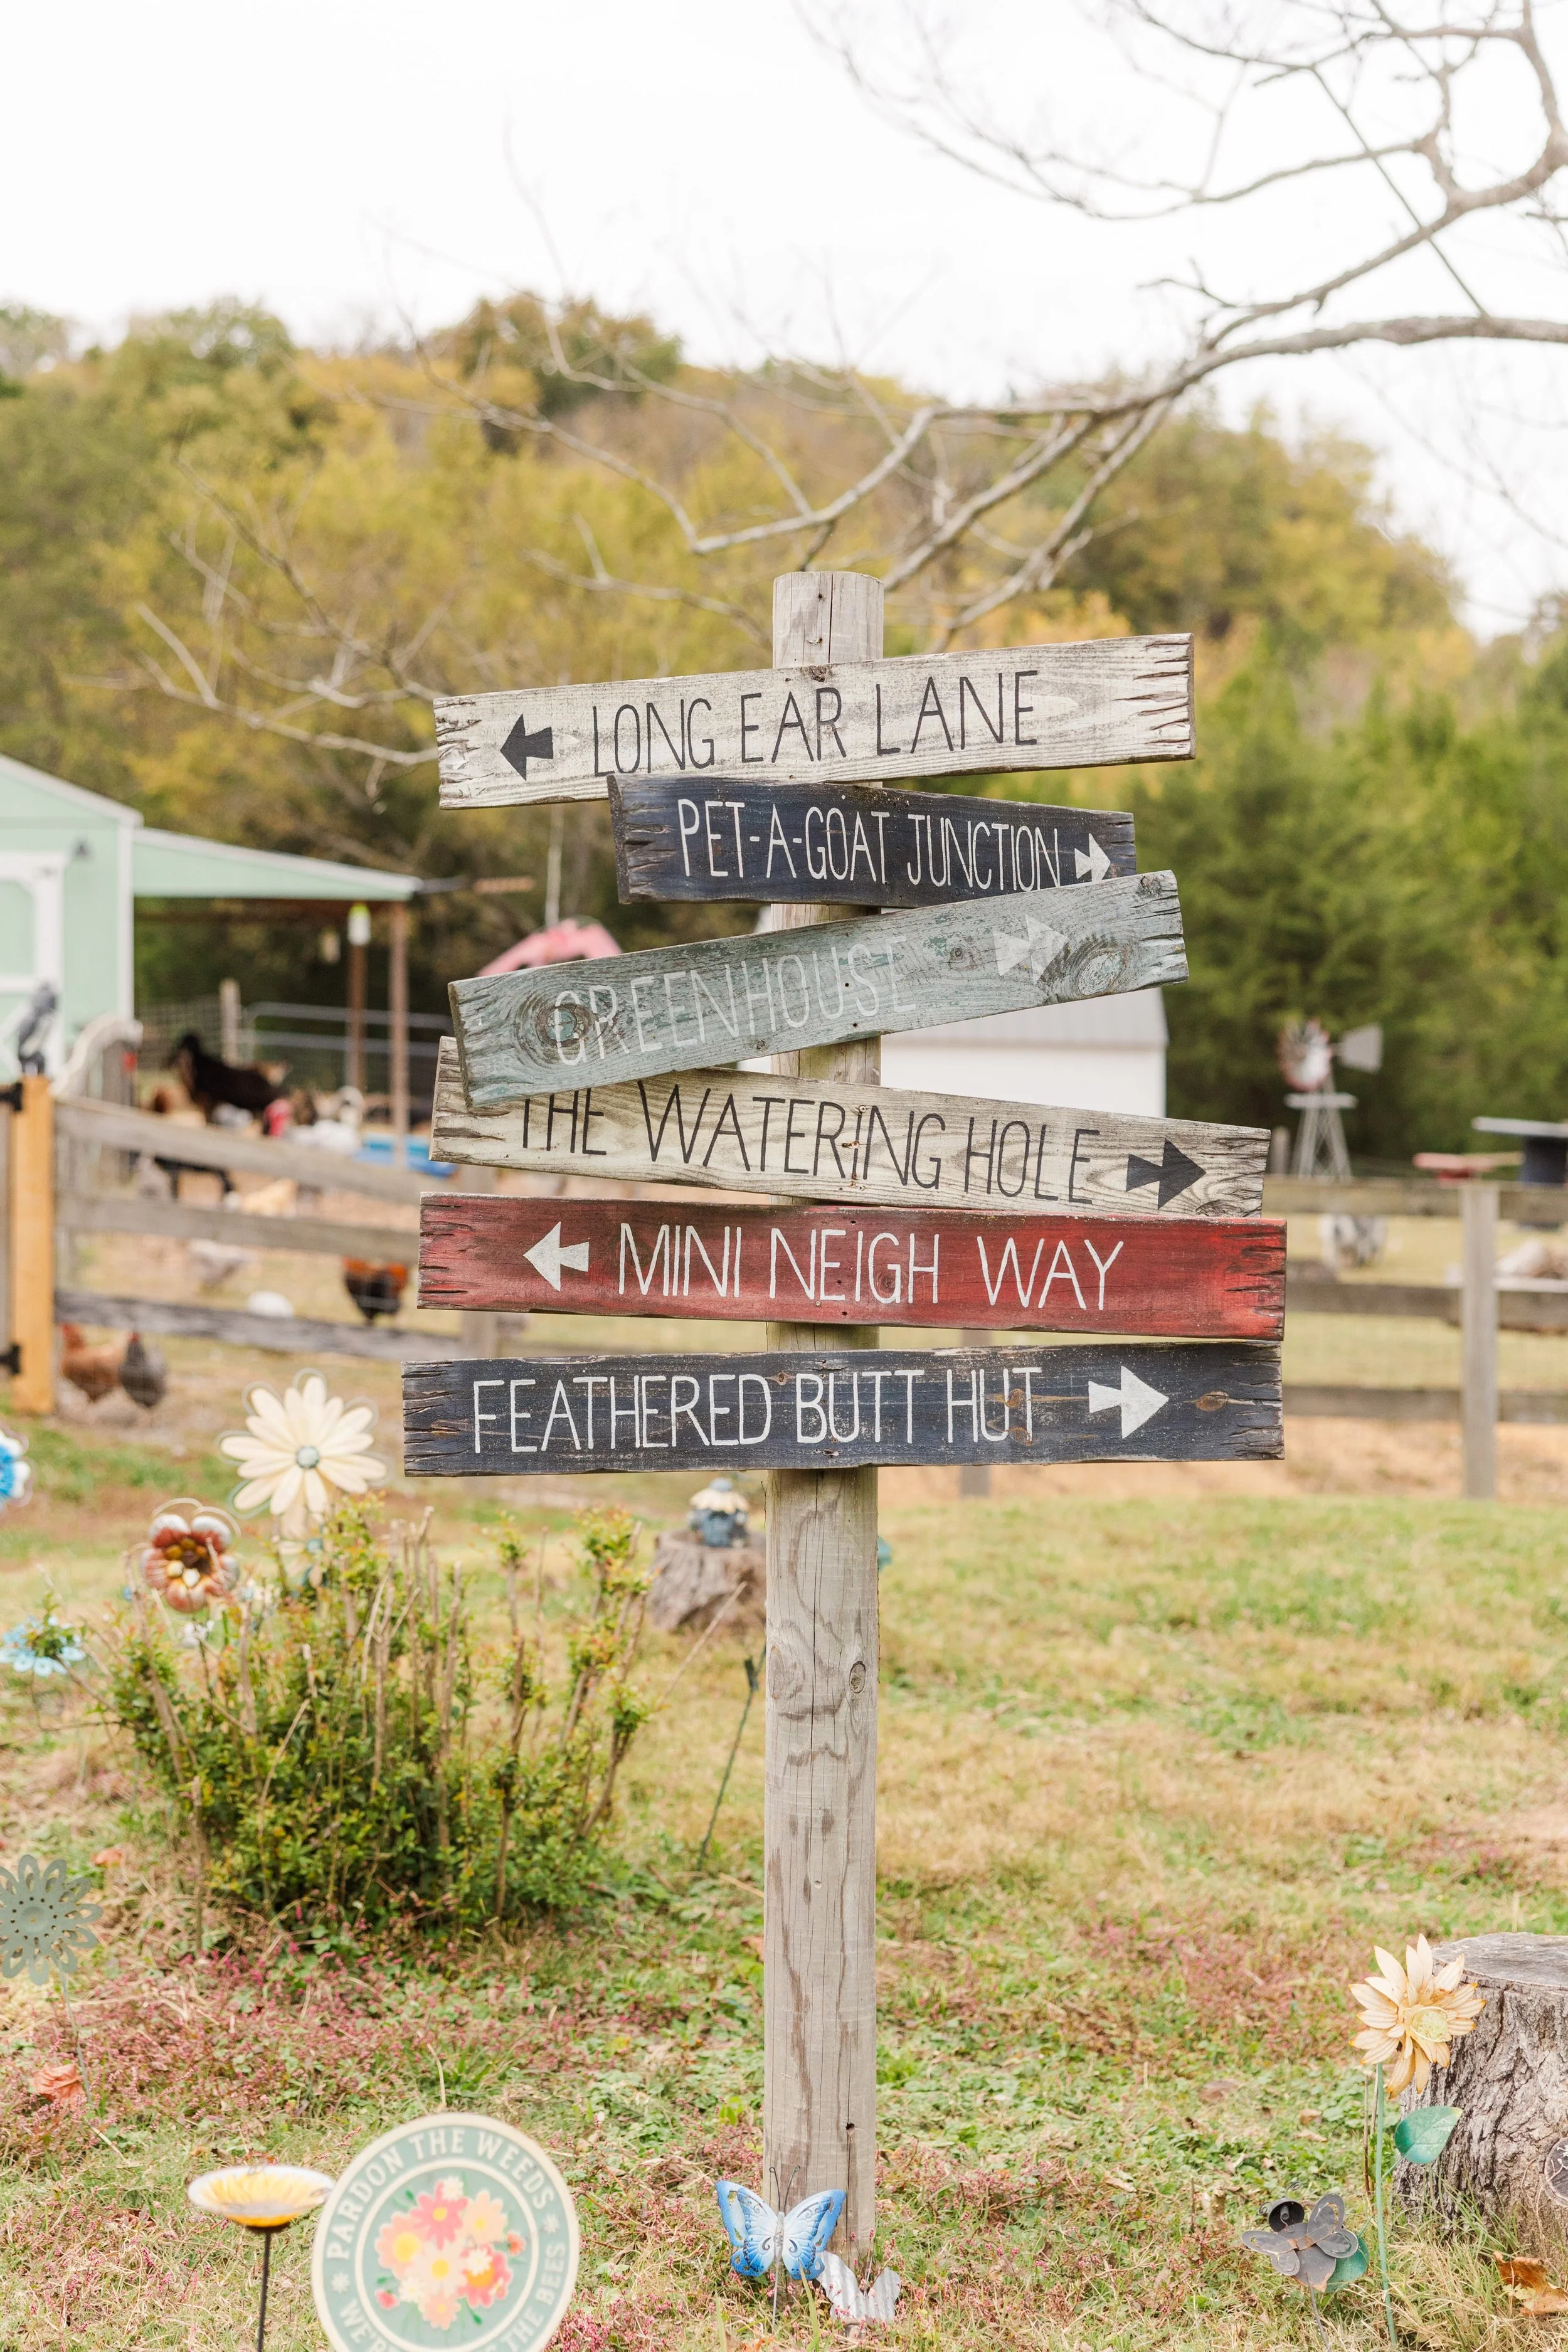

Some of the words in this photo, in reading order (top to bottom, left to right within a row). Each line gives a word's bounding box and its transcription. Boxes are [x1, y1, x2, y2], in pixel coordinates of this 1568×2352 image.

[593, 698, 715, 778] LONG
[740, 687, 847, 764] EAR
[876, 670, 1038, 756] LANE
[677, 798, 890, 885] PET-A-GOAT
[907, 813, 1061, 892] JUNCTION
[553, 937, 917, 1066] GREENHOUSE
[638, 1080, 946, 1190] WATERING
[963, 1117, 1100, 1205] HOLE
[618, 1222, 741, 1298] MINI
[769, 1228, 940, 1305] NEIGH
[977, 1236, 1124, 1311] WAY
[473, 1374, 773, 1454] FEATHERED
[795, 1369, 924, 1444] BUTT
[946, 1366, 1042, 1444] HUT
[327, 2145, 405, 2260] PARDON
[409, 2129, 465, 2161] THE
[477, 2130, 554, 2210] WEEDS
[535, 2242, 566, 2306] BEES
